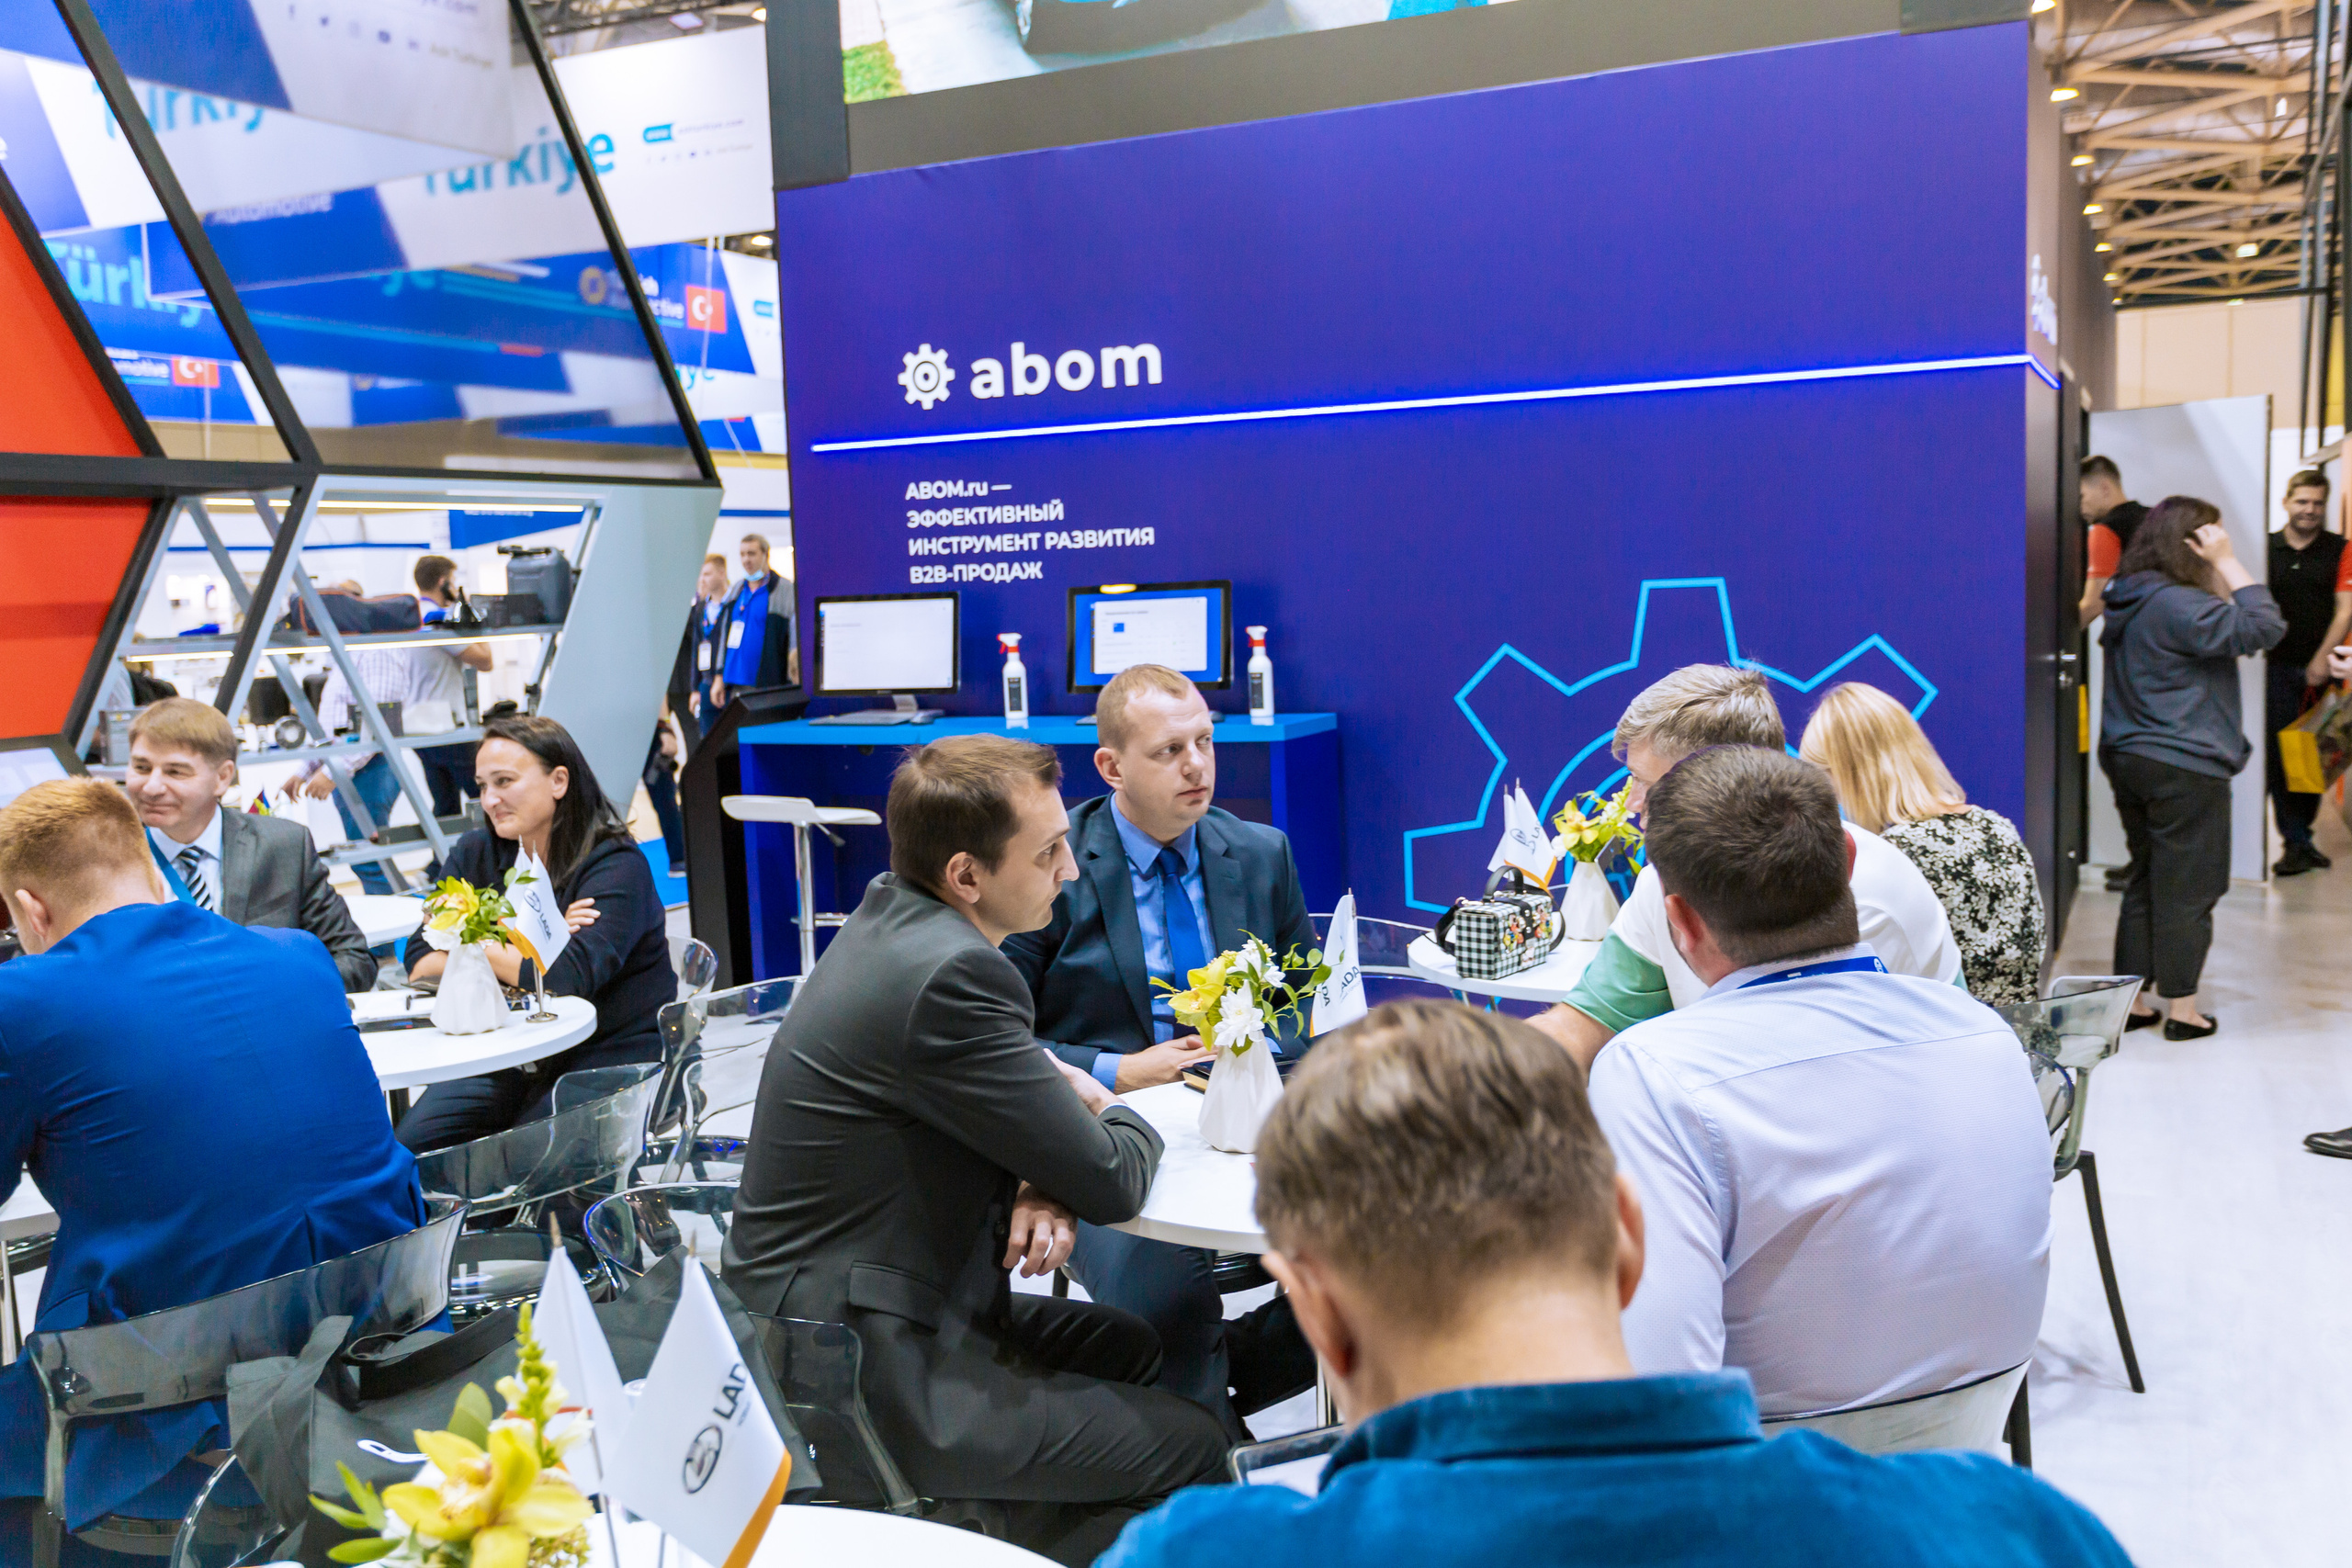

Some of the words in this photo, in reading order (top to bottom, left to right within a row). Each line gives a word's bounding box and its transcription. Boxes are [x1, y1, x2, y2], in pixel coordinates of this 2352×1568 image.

[970, 342, 1162, 399] abom
[906, 480, 988, 500] ABOM.ru
[907, 499, 1064, 528] ЭФФЕКТИВНЫЙ
[909, 533, 1041, 556] ИНСТРУМЕНТ
[1045, 527, 1154, 549] РАЗВИТИЯ
